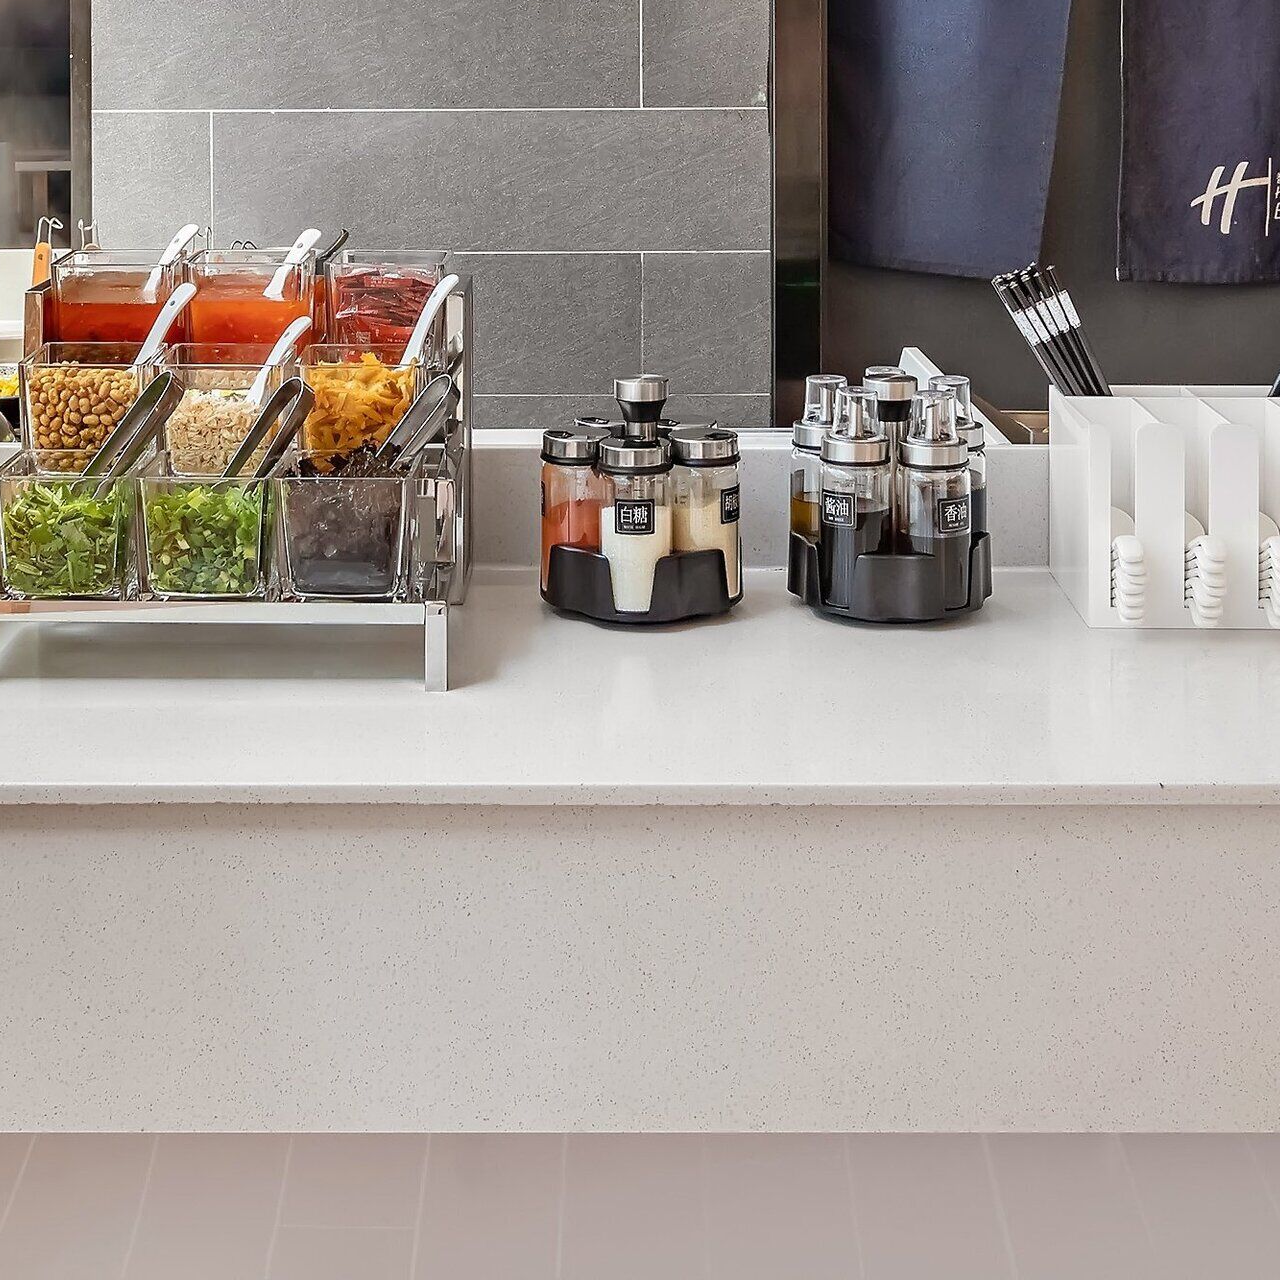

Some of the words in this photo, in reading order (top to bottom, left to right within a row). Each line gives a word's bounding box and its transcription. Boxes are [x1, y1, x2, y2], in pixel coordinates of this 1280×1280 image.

[620, 506, 648, 524] 白糖
[825, 496, 849, 516] 酱油
[944, 502, 967, 521] 香油
